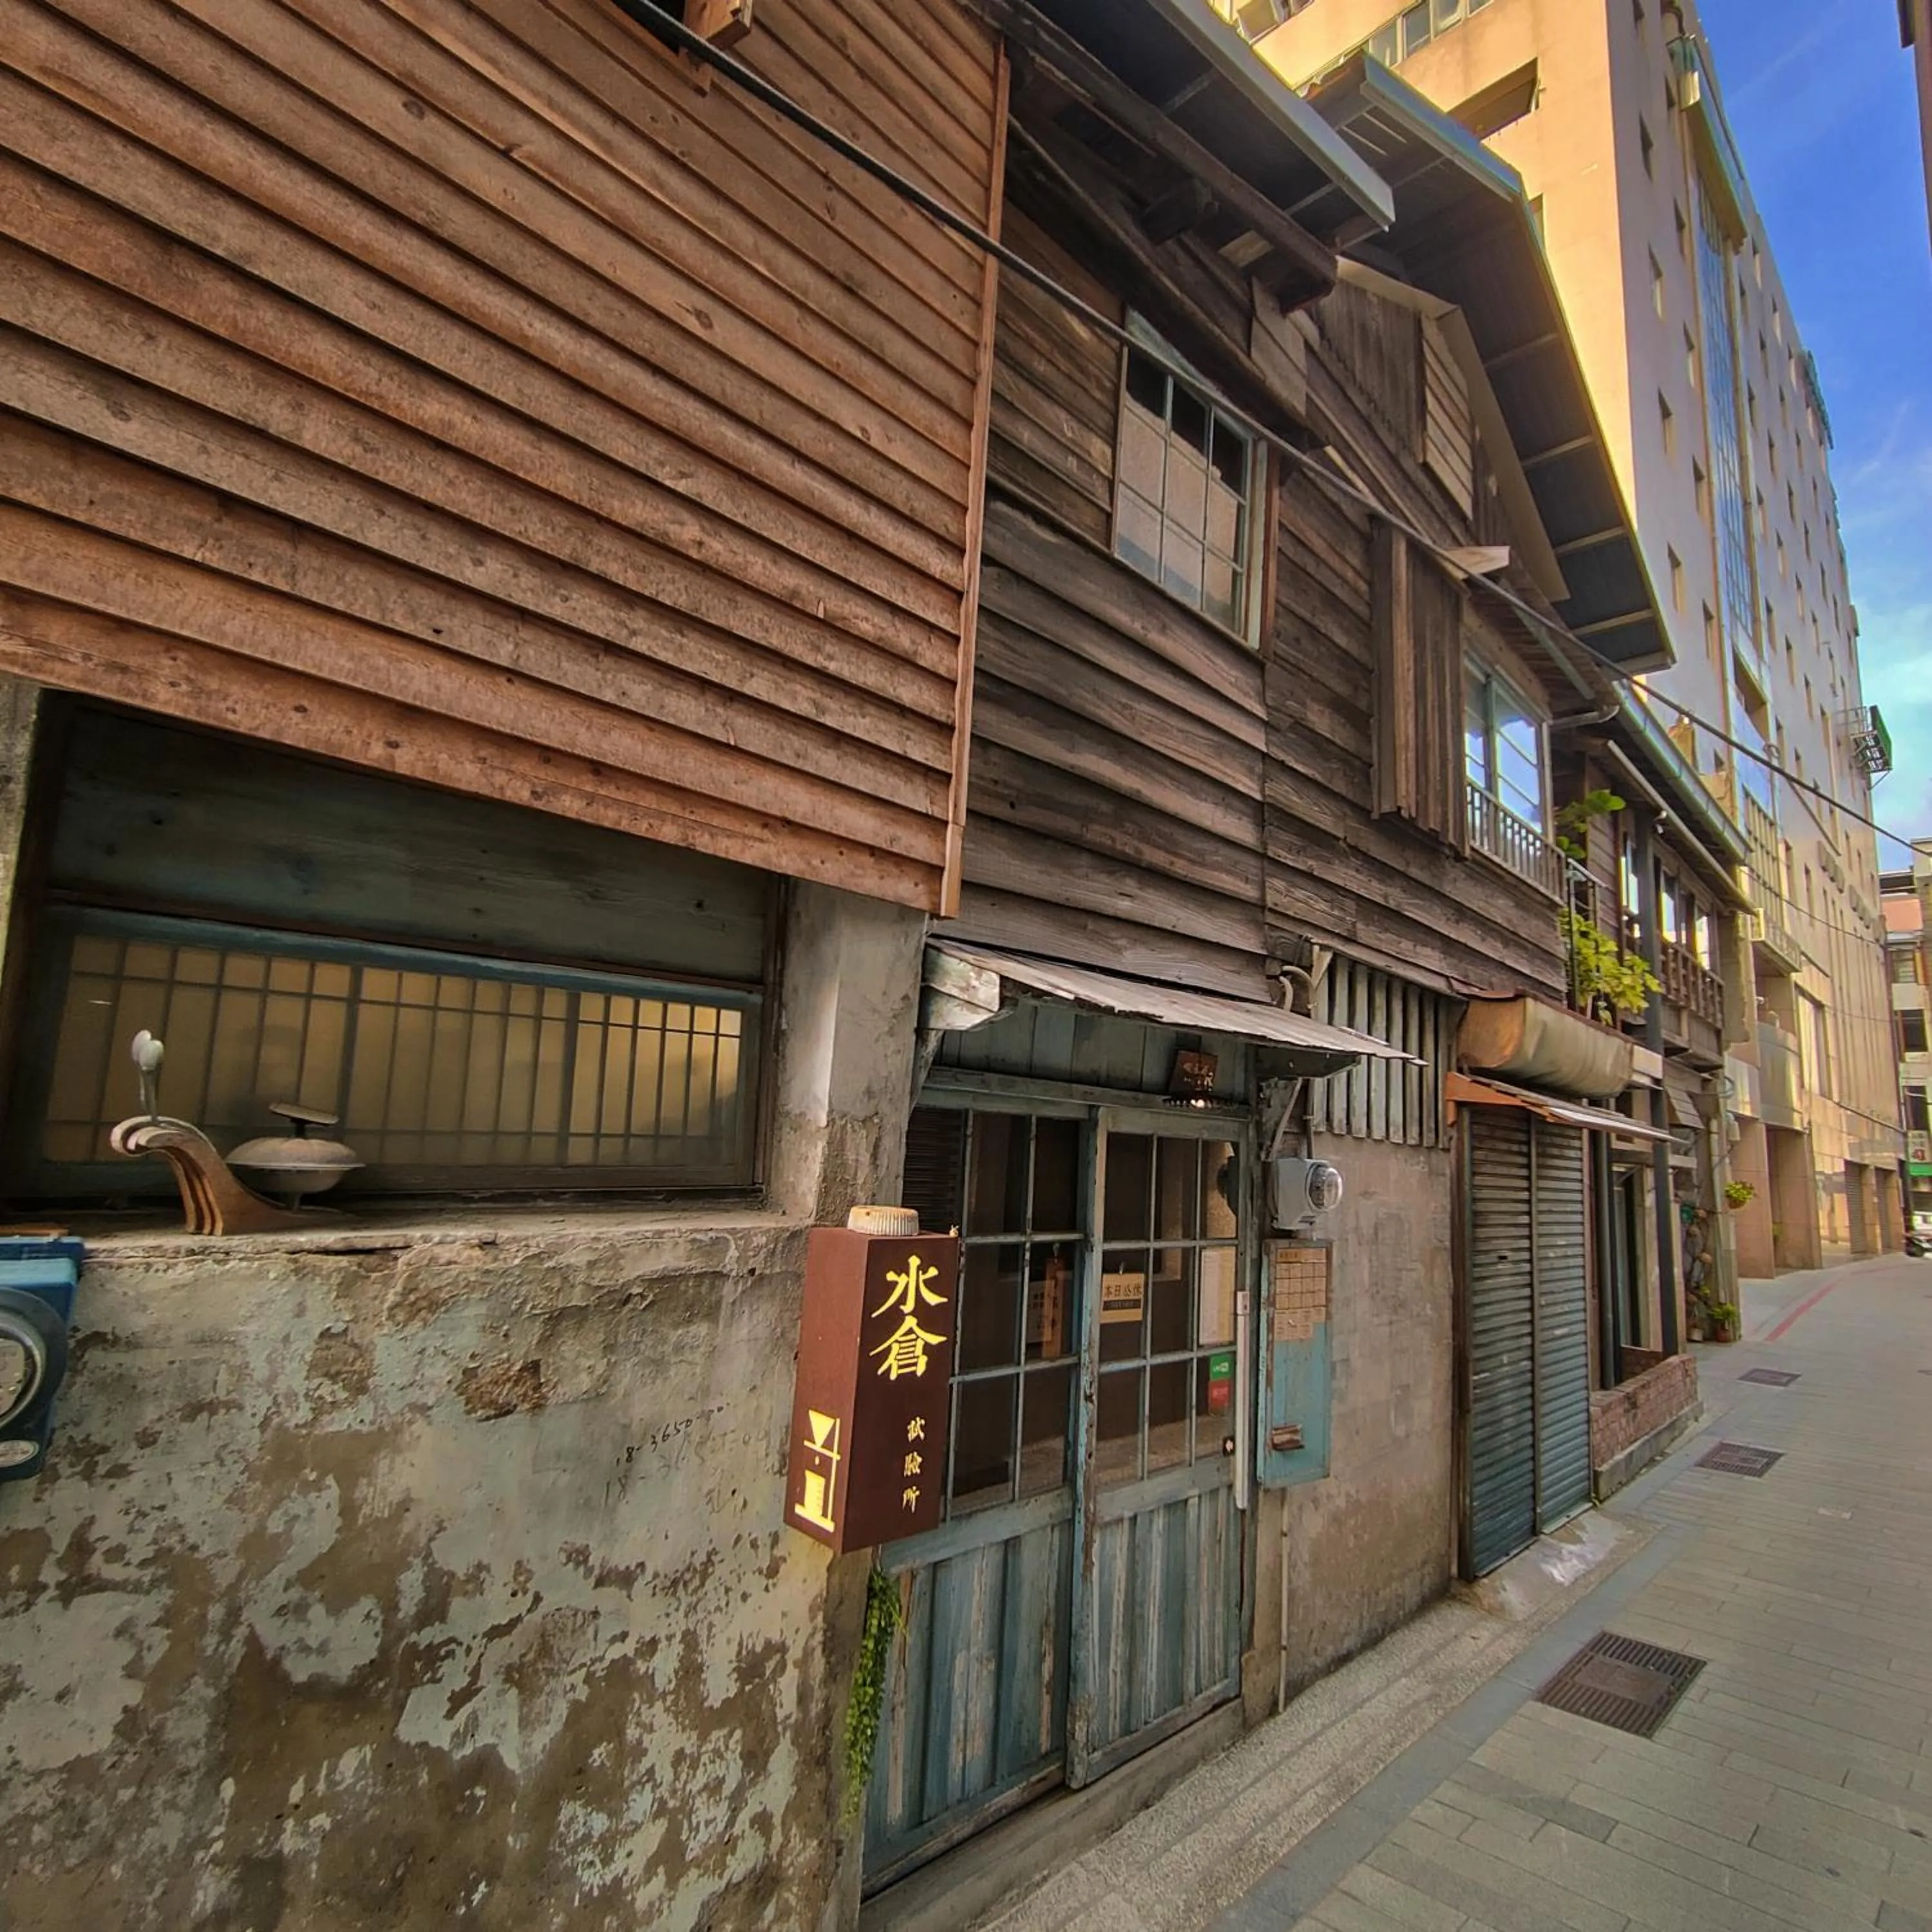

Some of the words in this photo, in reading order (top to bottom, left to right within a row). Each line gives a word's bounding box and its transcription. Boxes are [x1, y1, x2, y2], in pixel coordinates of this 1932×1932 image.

[869, 1254, 948, 1381] 水倉
[1104, 1282, 1142, 1298] 本日公休
